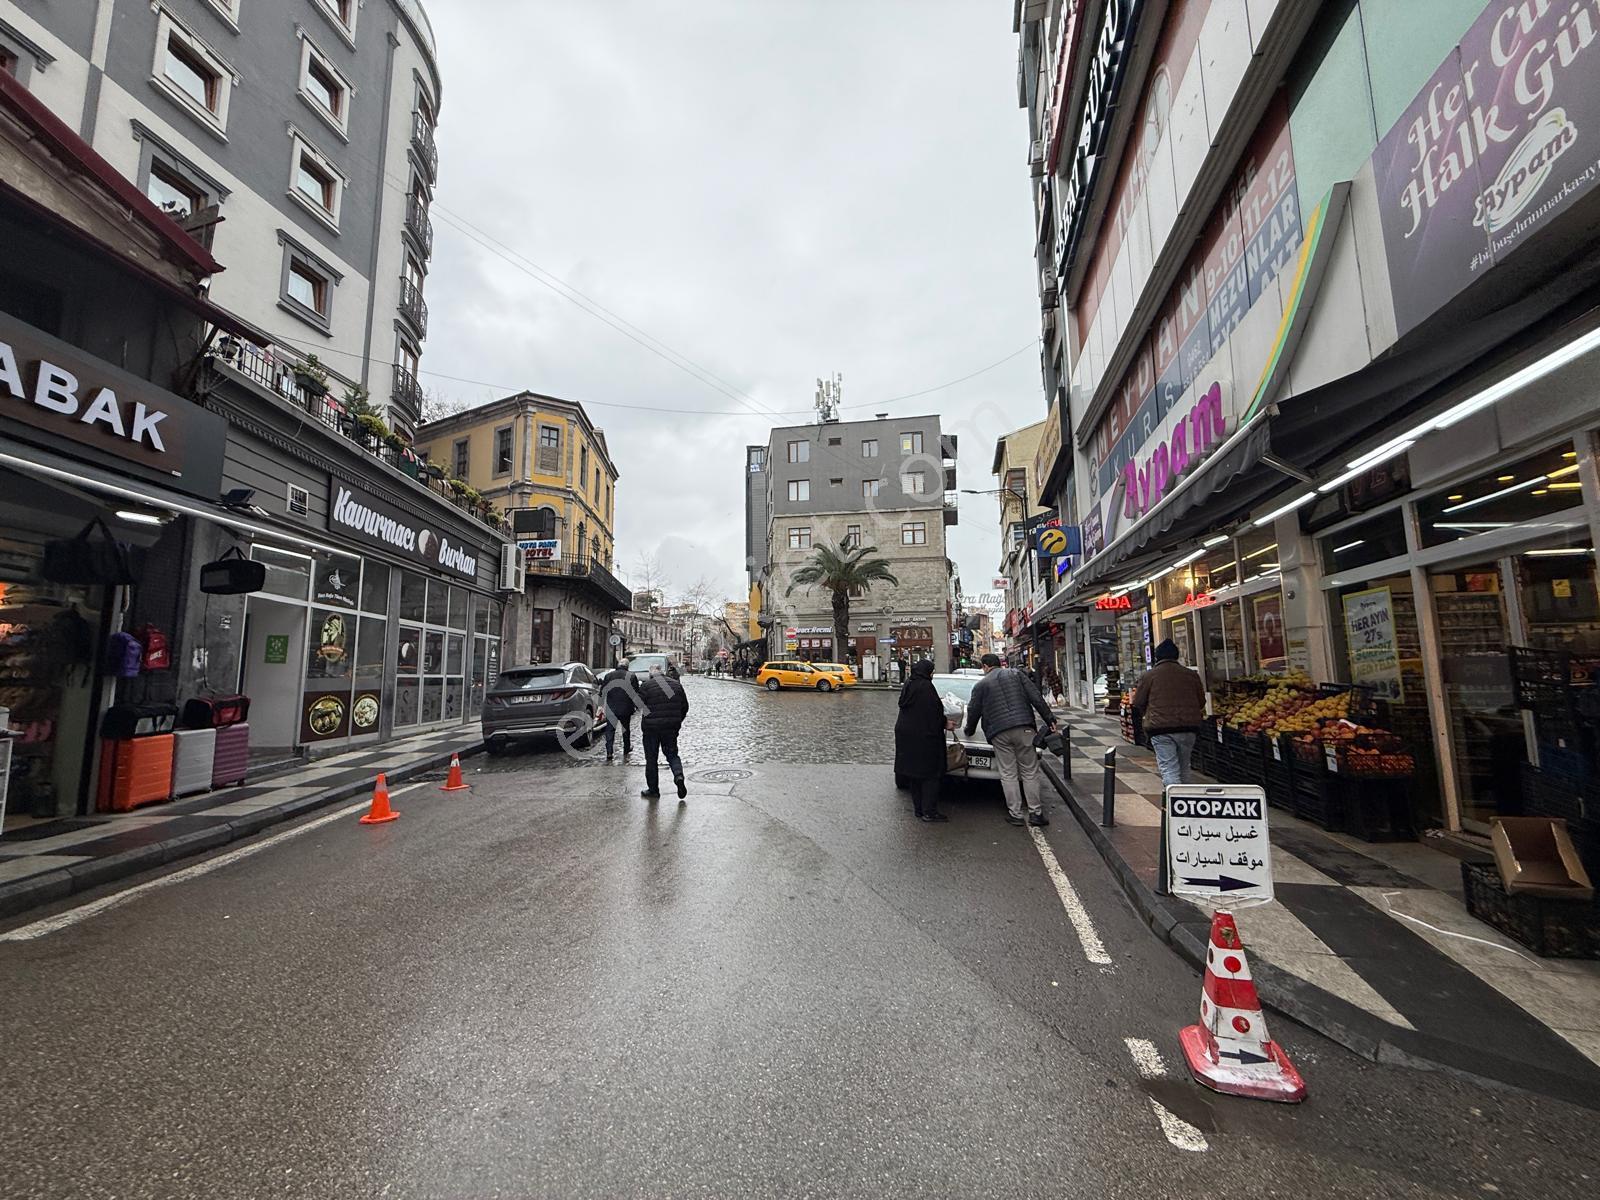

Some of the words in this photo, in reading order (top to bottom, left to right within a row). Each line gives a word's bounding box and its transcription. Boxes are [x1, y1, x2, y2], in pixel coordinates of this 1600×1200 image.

[1401, 105, 1518, 239] Halk
[1514, 0, 1600, 121] Gü
[1407, 60, 1479, 173] Her
[1209, 193, 1297, 334] MEZUNLAR
[1099, 262, 1201, 458] MEYDAN
[1124, 380, 1226, 520] Aypam
[333, 486, 416, 552] Kavurmacı
[438, 537, 476, 577] Burhan
[1351, 615, 1371, 633] HER
[1370, 607, 1390, 627] AYIN
[975, 757, 988, 767] 852
[1173, 799, 1259, 818] OTOPARK
[1177, 824, 1221, 841] سيارات
[1225, 825, 1259, 843] غسيل
[1175, 850, 1224, 868] السيارات
[1229, 851, 1264, 871] موقف
